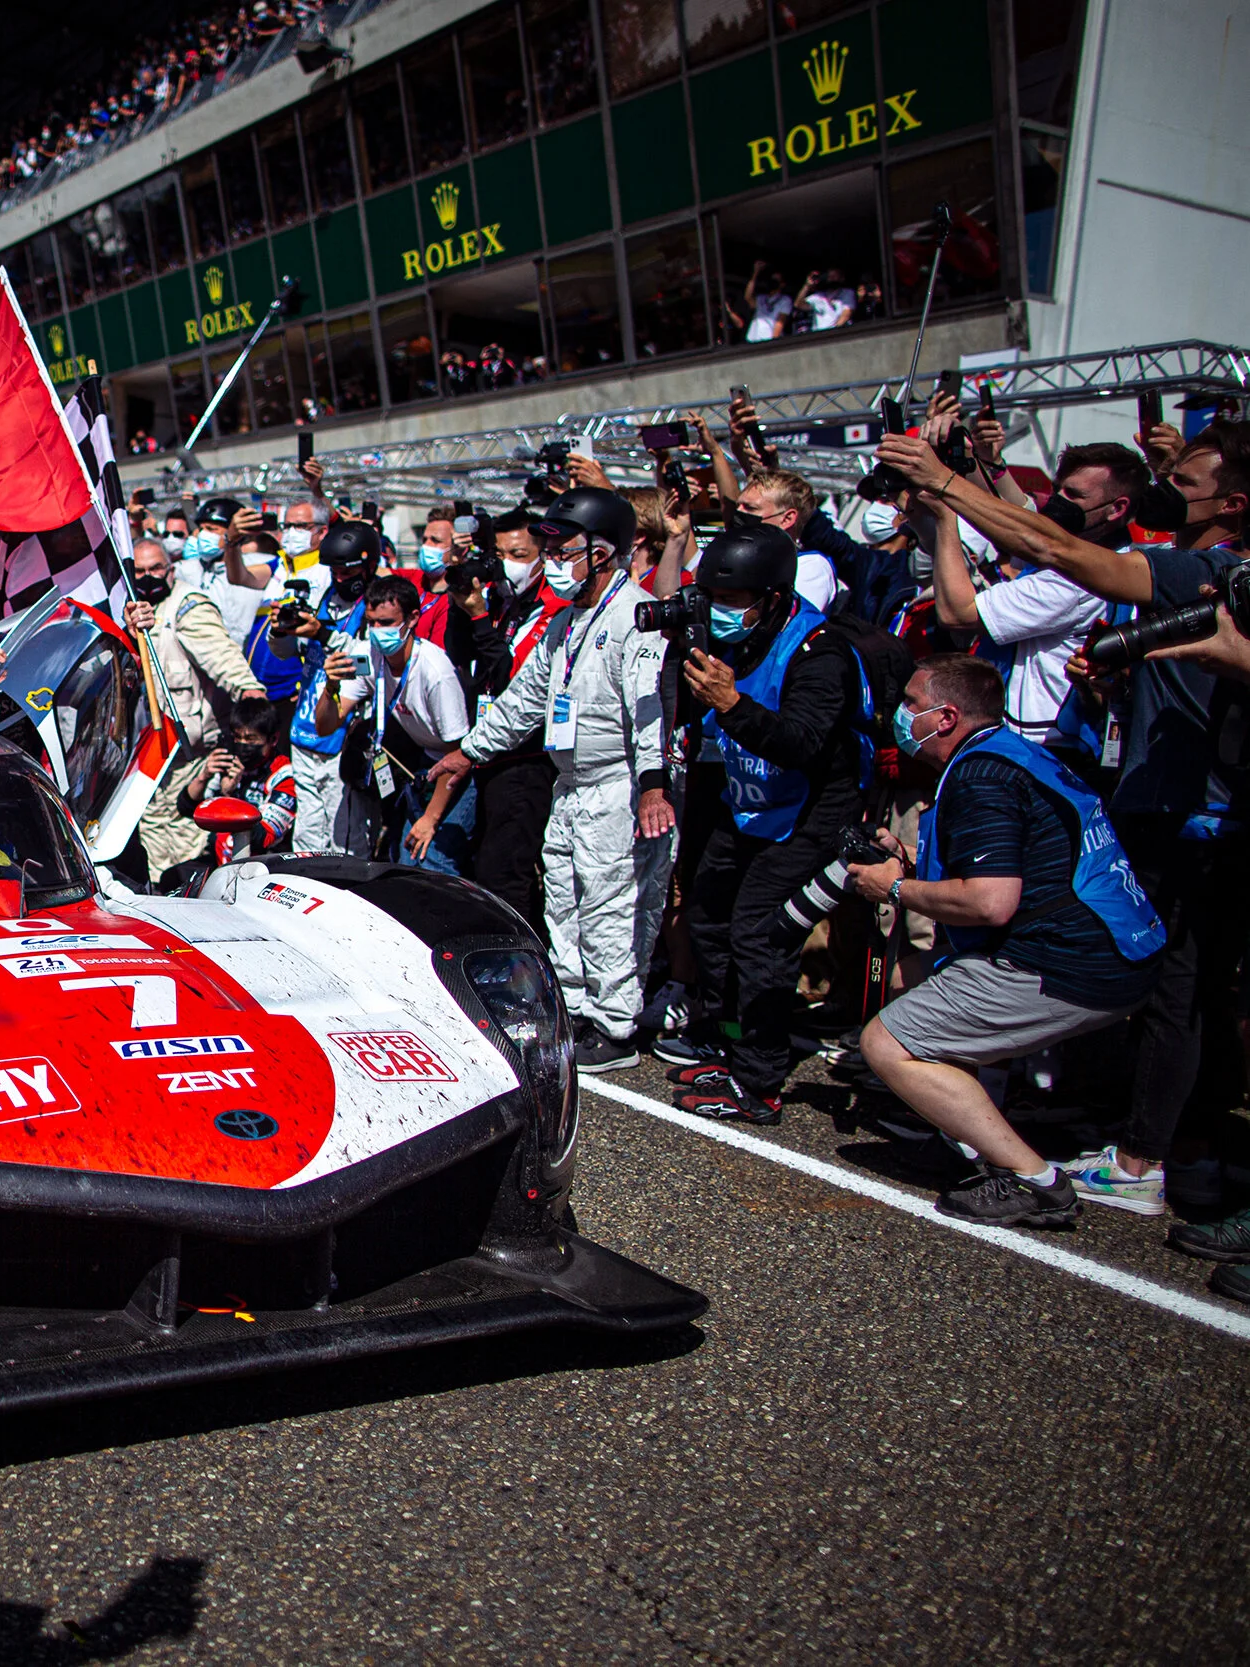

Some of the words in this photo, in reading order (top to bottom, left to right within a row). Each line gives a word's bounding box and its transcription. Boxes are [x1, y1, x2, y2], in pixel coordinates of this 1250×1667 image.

[747, 88, 923, 177] ROLEX
[402, 223, 506, 281] ROLEX
[184, 301, 255, 345] ROLEX
[273, 897, 294, 910] Racing
[278, 892, 300, 903] GAZOO
[284, 887, 307, 899] TOYOTA
[302, 897, 325, 915] 7
[20, 935, 99, 945] WEC
[76, 956, 170, 966] TotalEnergies
[872, 957, 881, 982] EOS
[59, 975, 177, 1029] 7
[121, 1036, 244, 1057] AISIN
[338, 1035, 422, 1051] HYPER
[358, 1050, 448, 1076] CAR
[157, 1068, 258, 1093] ZENT
